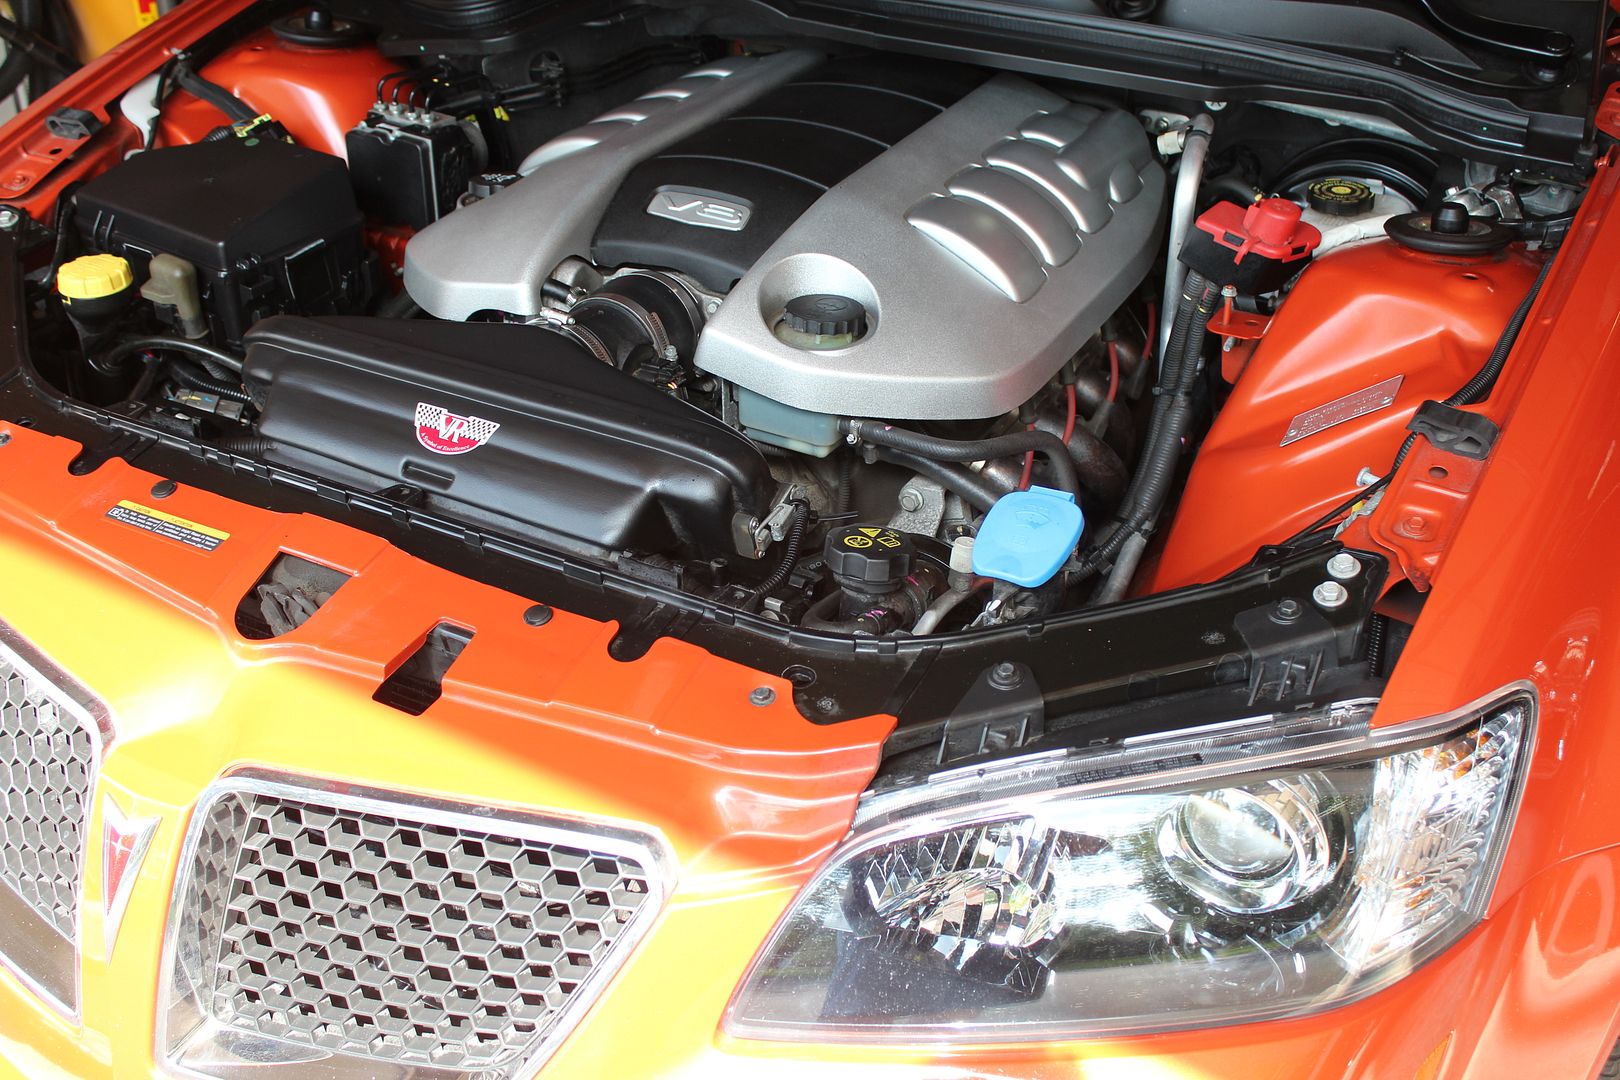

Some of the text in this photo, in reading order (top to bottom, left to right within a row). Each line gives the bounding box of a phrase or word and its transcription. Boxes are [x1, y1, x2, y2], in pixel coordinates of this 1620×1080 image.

[660, 193, 743, 224] V8
[422, 436, 437, 447] Symbol
[439, 414, 469, 443] VR
